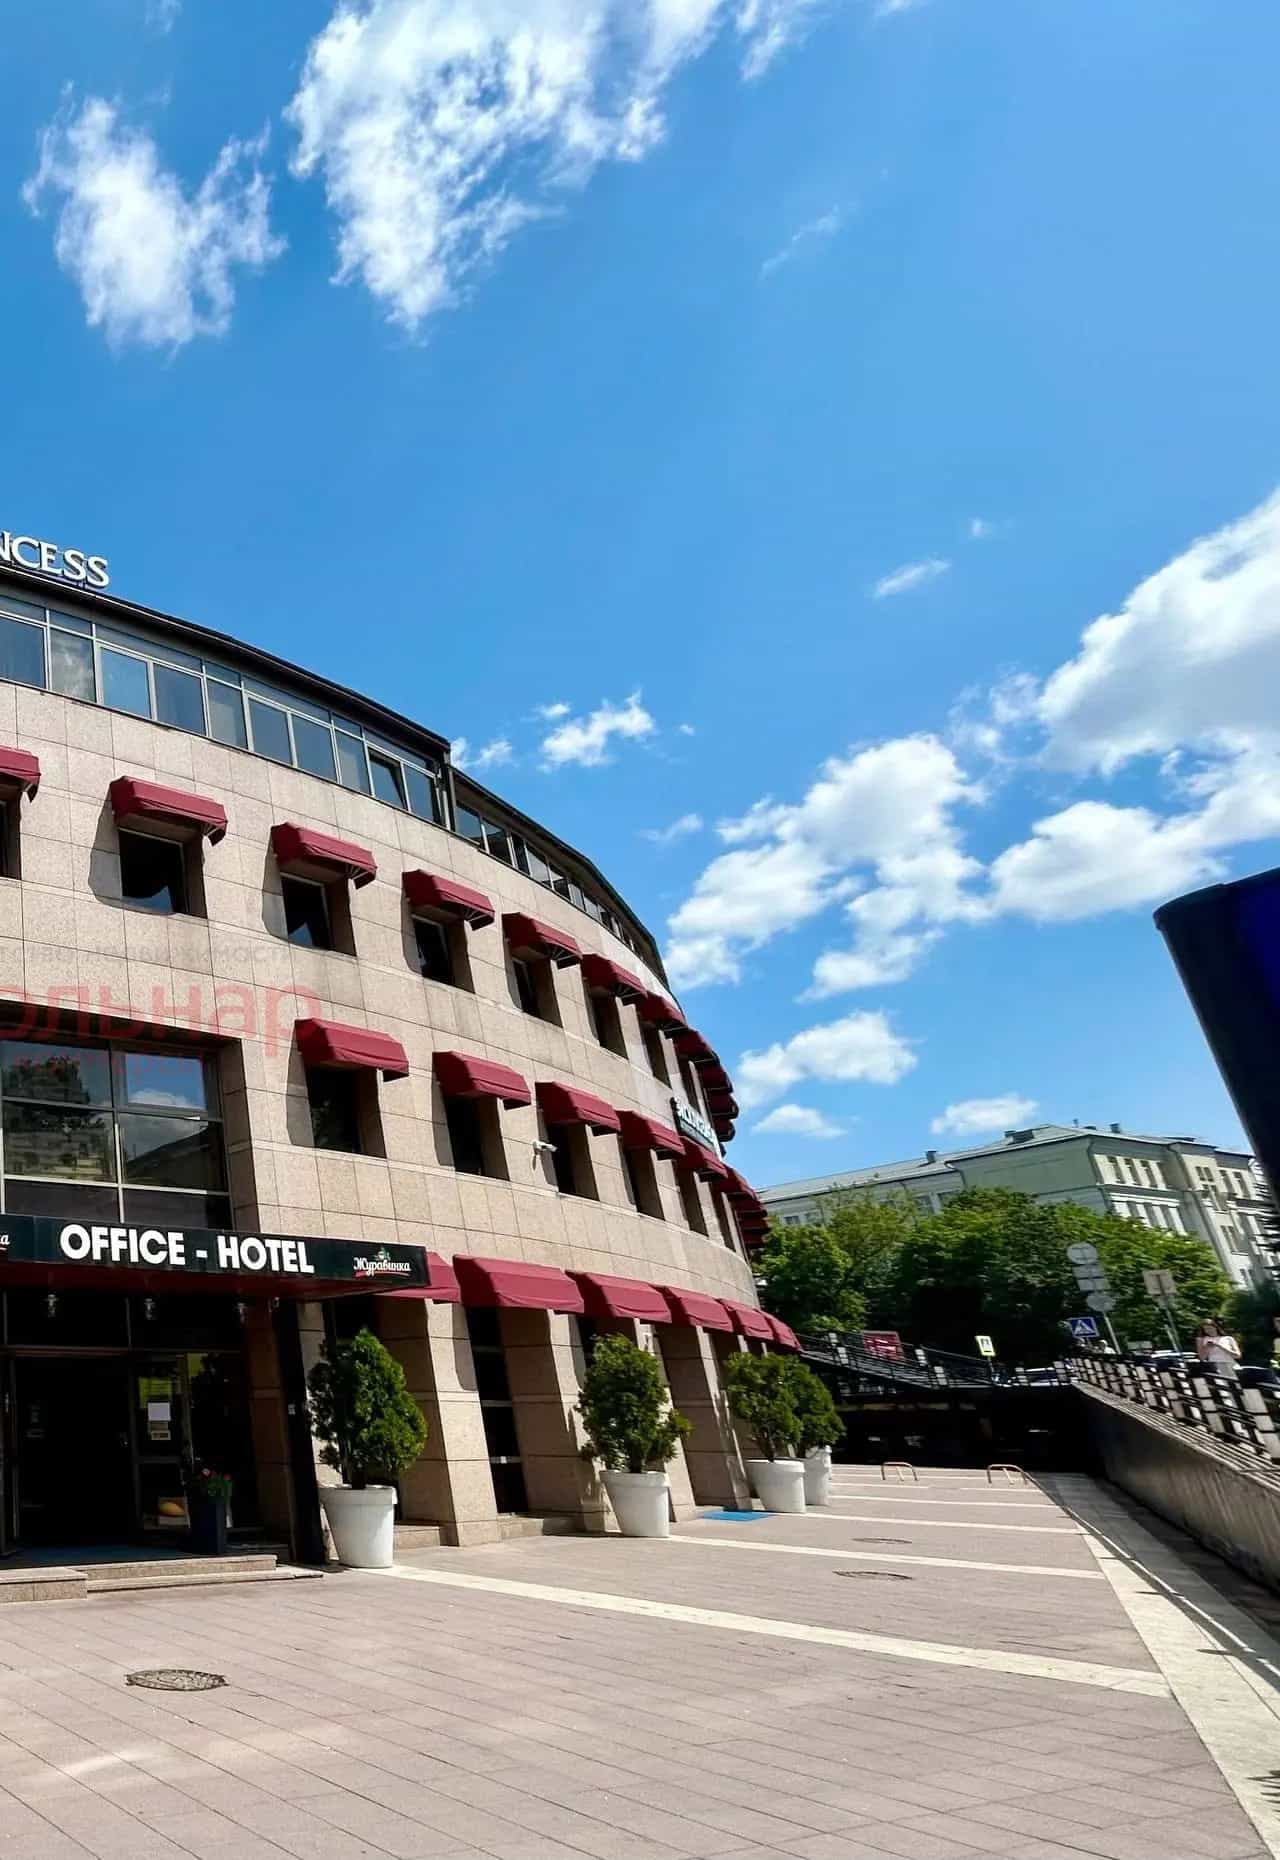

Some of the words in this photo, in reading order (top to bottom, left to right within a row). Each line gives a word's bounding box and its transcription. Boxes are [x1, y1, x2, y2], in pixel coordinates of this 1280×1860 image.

[60, 1223, 186, 1266] OFFICE
[217, 1235, 315, 1274] HOTEL
[353, 1256, 412, 1276] Журавинка
